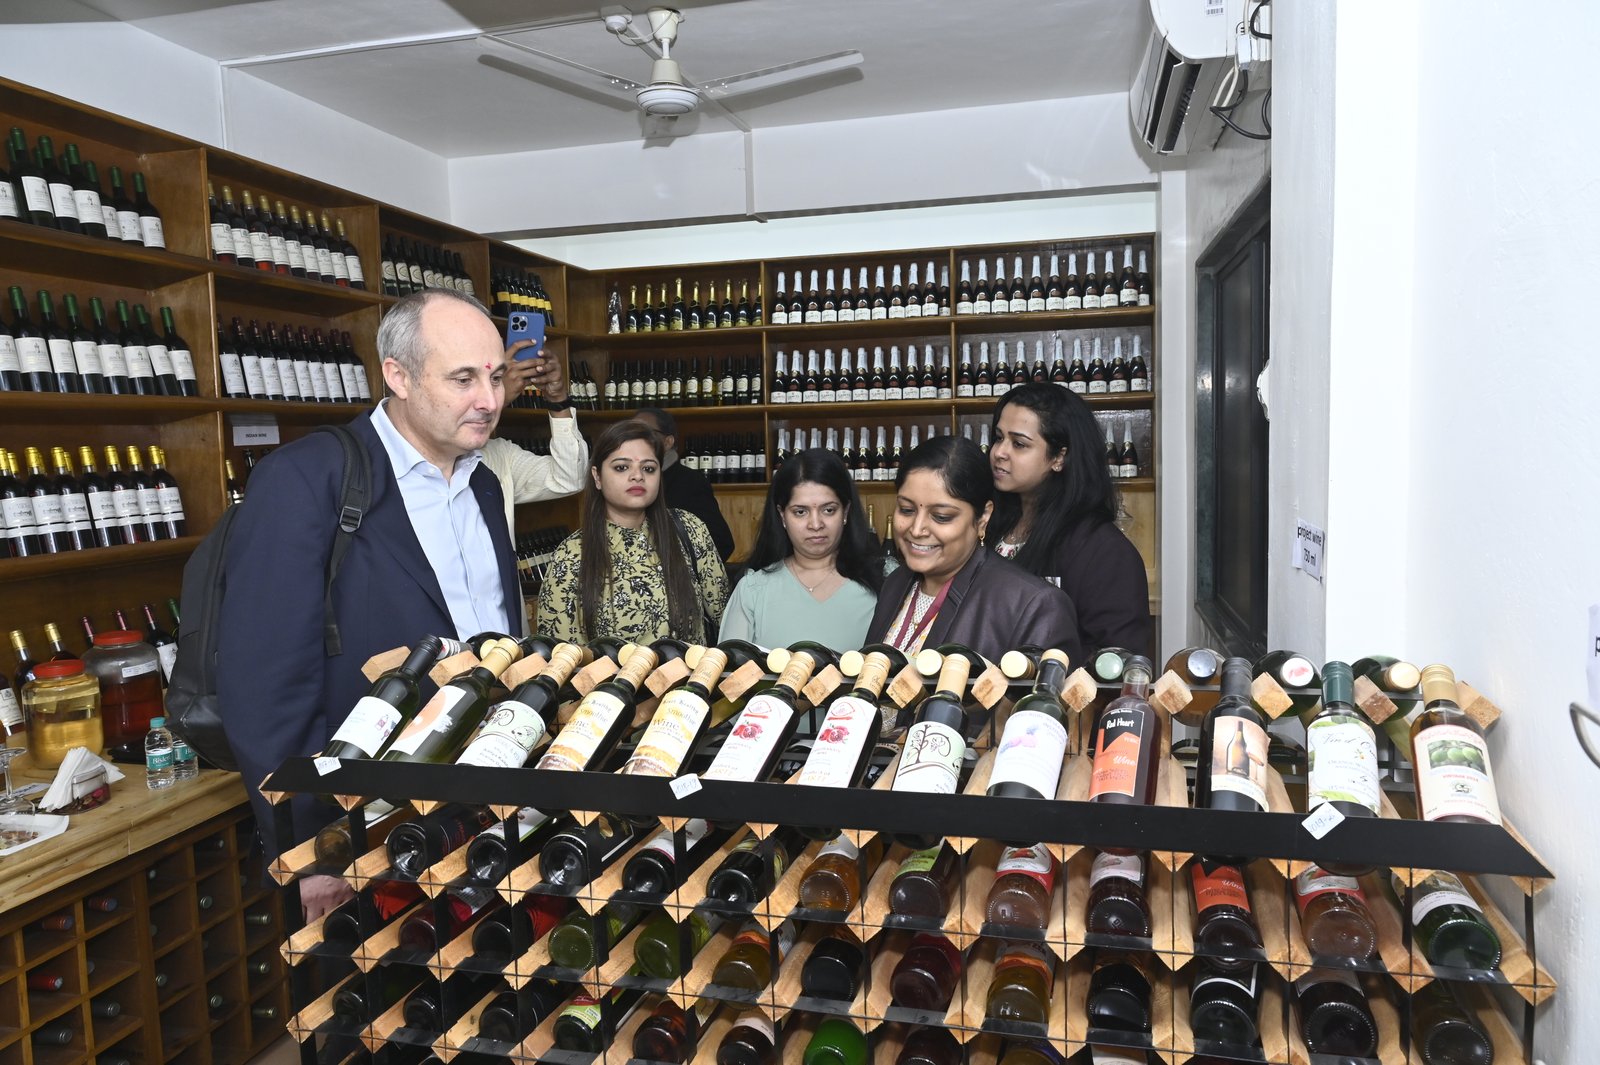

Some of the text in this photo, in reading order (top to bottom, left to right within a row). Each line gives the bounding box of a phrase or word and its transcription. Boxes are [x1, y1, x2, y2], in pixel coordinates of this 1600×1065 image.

[1297, 526, 1322, 546] project wine
[1310, 553, 1317, 566] ml
[1106, 717, 1135, 730] Red Heart
[1113, 755, 1136, 766] Wine
